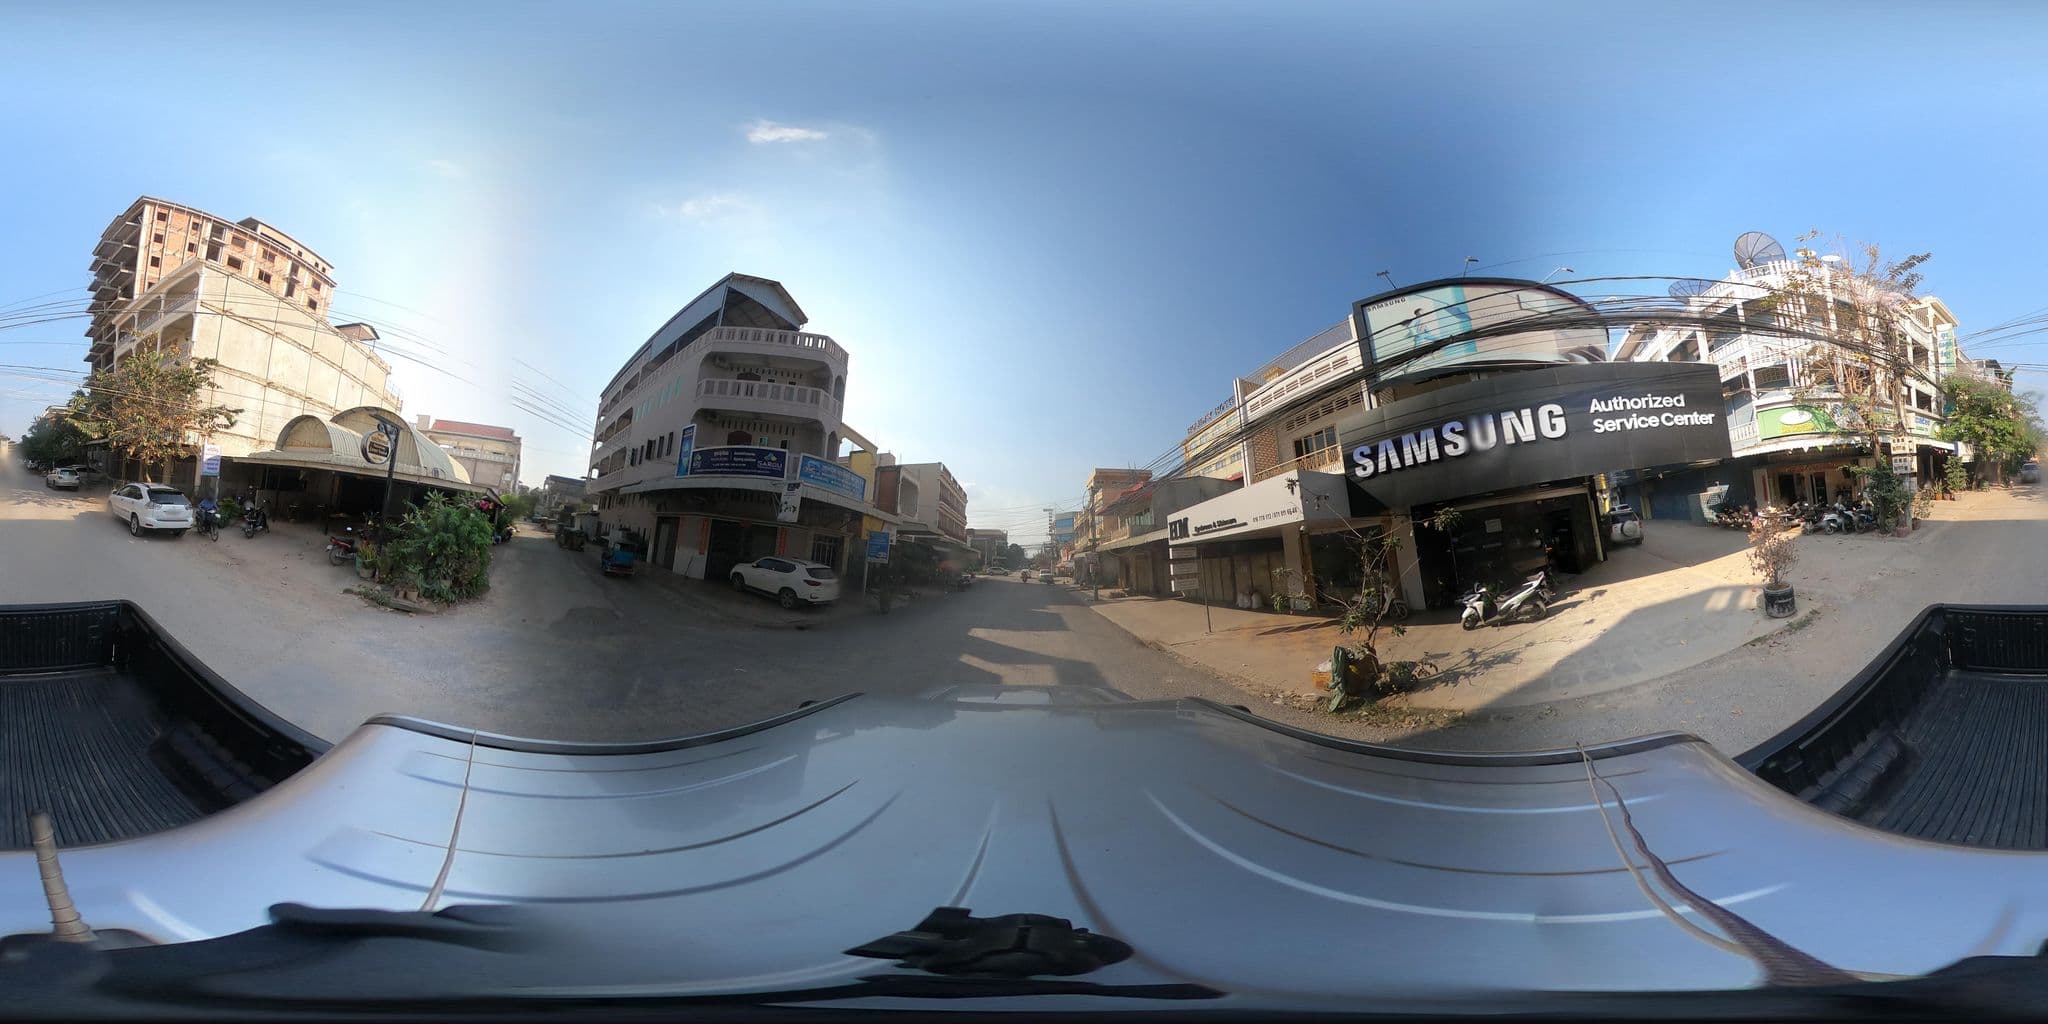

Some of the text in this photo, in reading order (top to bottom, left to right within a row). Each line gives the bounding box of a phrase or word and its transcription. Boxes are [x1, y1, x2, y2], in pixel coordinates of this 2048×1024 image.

[1367, 297, 1406, 313] SAMSUNG
[1589, 392, 1685, 415] Authorized
[1592, 410, 1715, 434] Service Center
[1352, 403, 1568, 479] SAMSUNG
